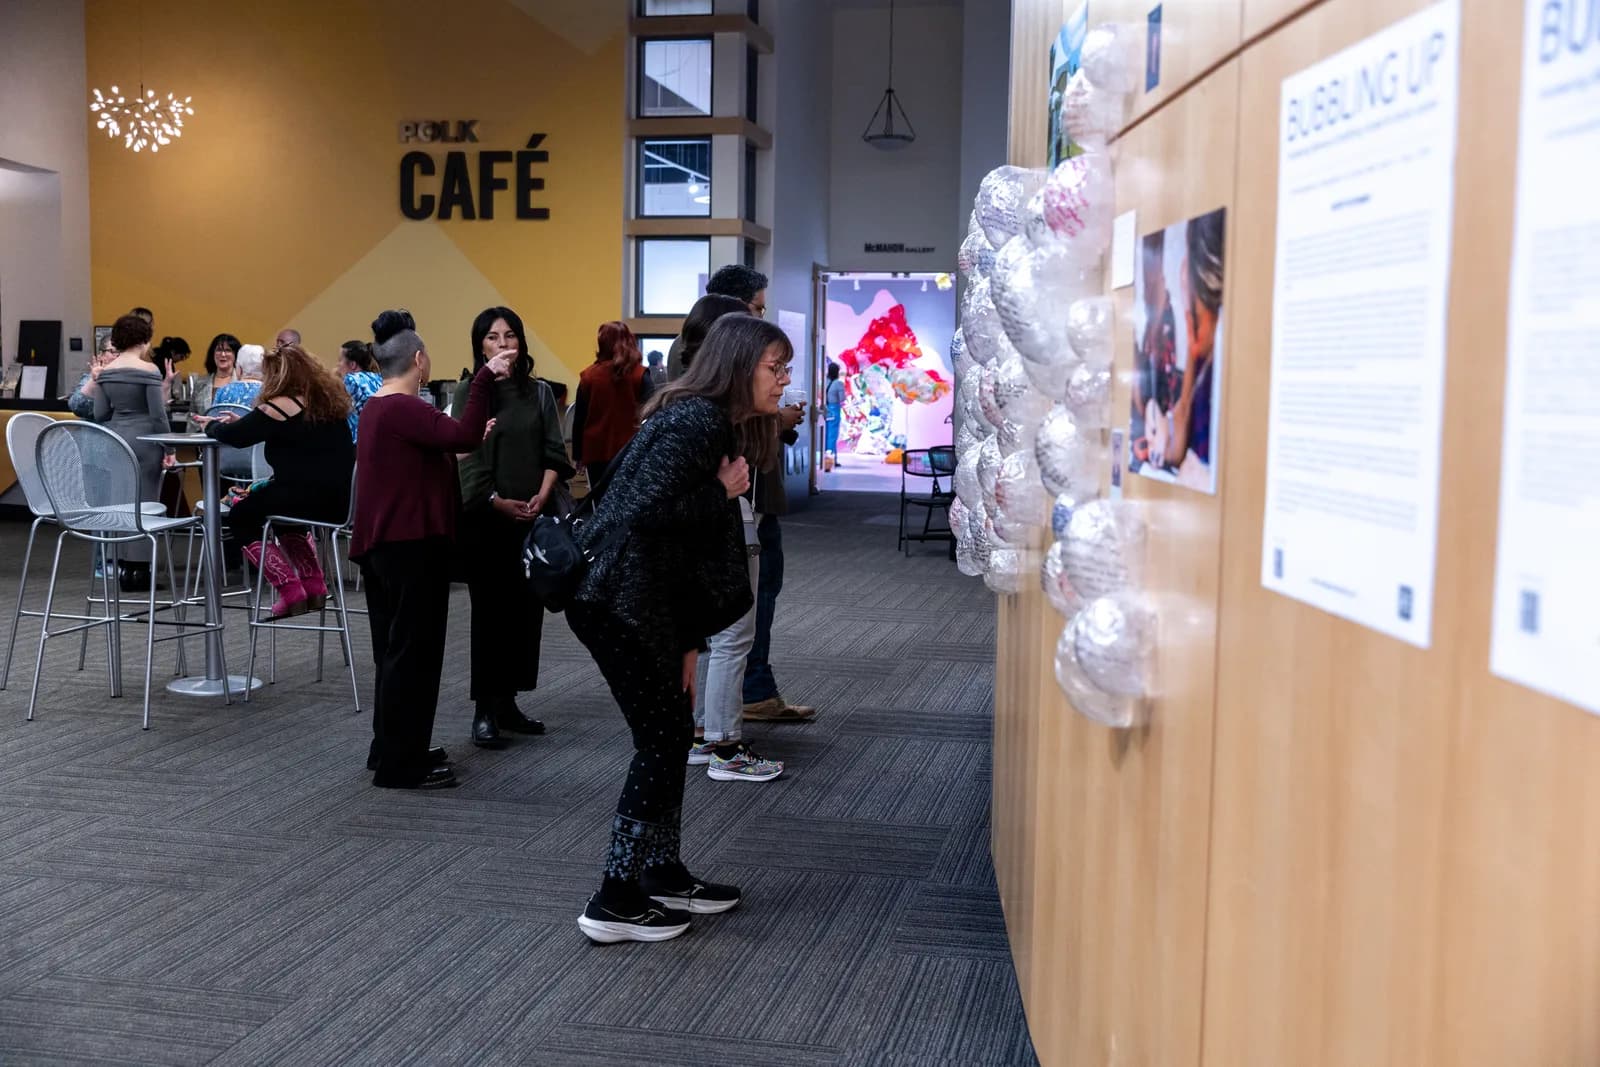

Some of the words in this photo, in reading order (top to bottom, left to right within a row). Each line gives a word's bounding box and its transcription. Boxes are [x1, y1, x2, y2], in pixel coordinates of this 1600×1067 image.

[1540, 1, 1600, 64] BU
[1287, 52, 1398, 142] BUBBLING
[1407, 31, 1445, 94] UP
[399, 119, 479, 143] POLK
[400, 133, 550, 220] CAFÉ
